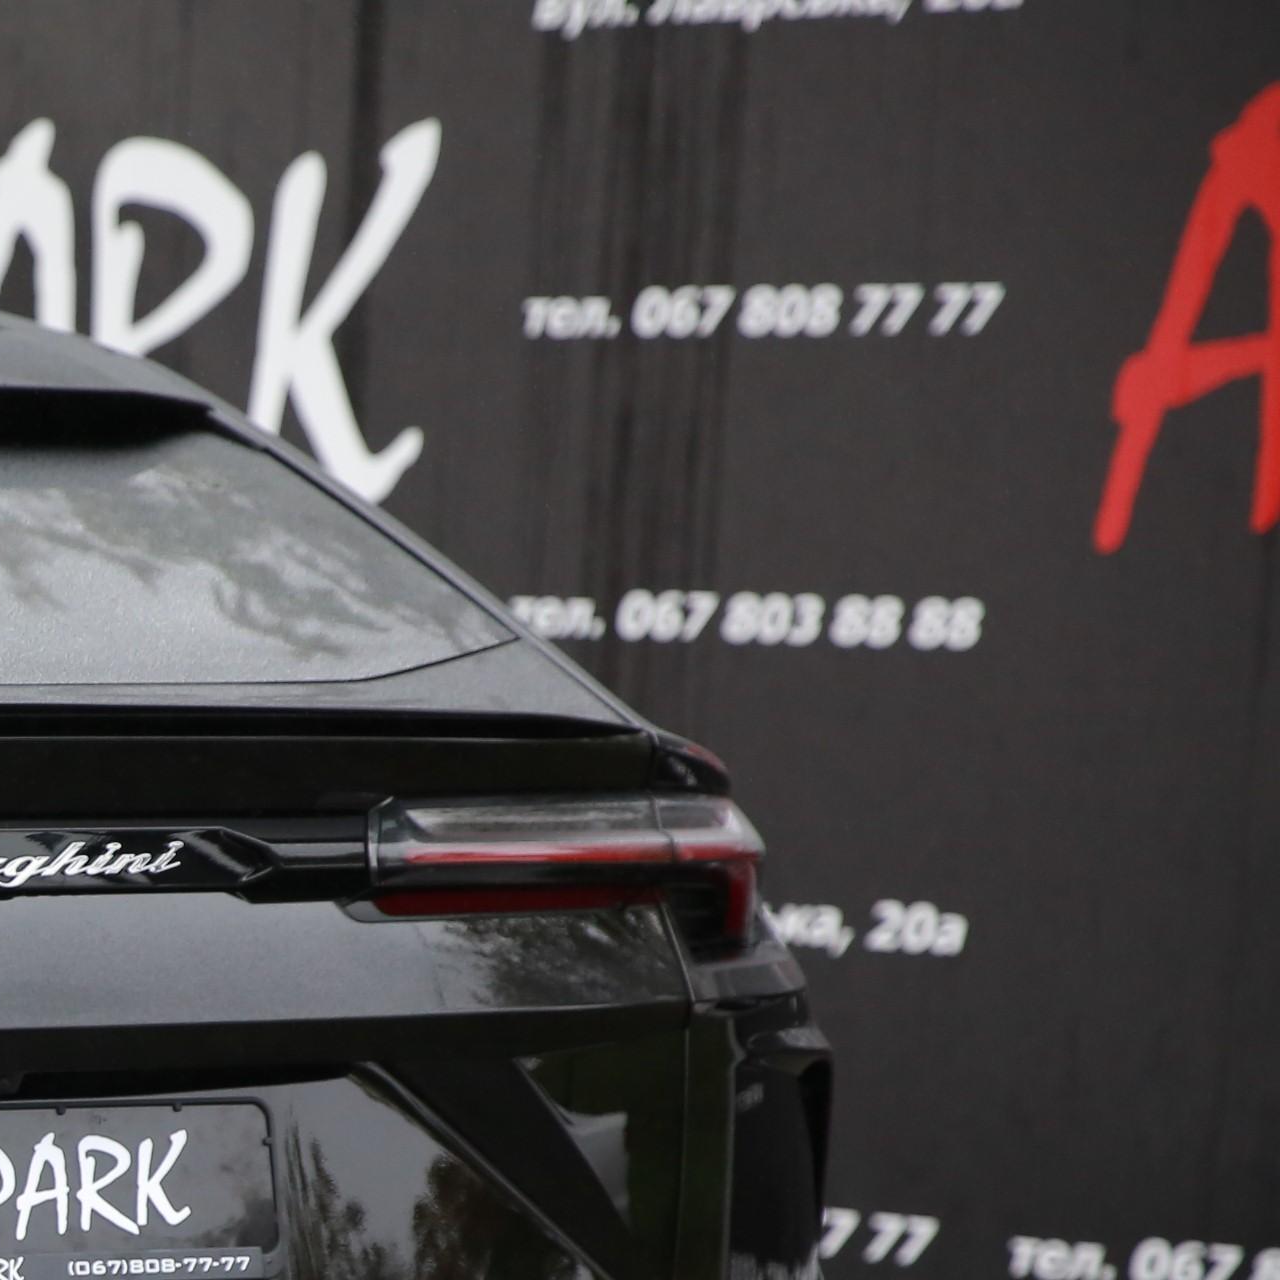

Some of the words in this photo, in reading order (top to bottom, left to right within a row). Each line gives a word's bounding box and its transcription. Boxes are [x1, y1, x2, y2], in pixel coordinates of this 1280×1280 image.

[522, 294, 622, 340] тел.
[630, 284, 736, 340] 067
[736, 282, 844, 340] 808
[849, 282, 925, 338] 77
[929, 281, 1007, 337] 77
[614, 588, 721, 643] 067
[719, 591, 827, 648] 803
[828, 593, 906, 650] 88
[908, 595, 986, 652] 88
[67, 1256, 251, 1277] (067)808-77-77
[863, 1211, 940, 1267] 77
